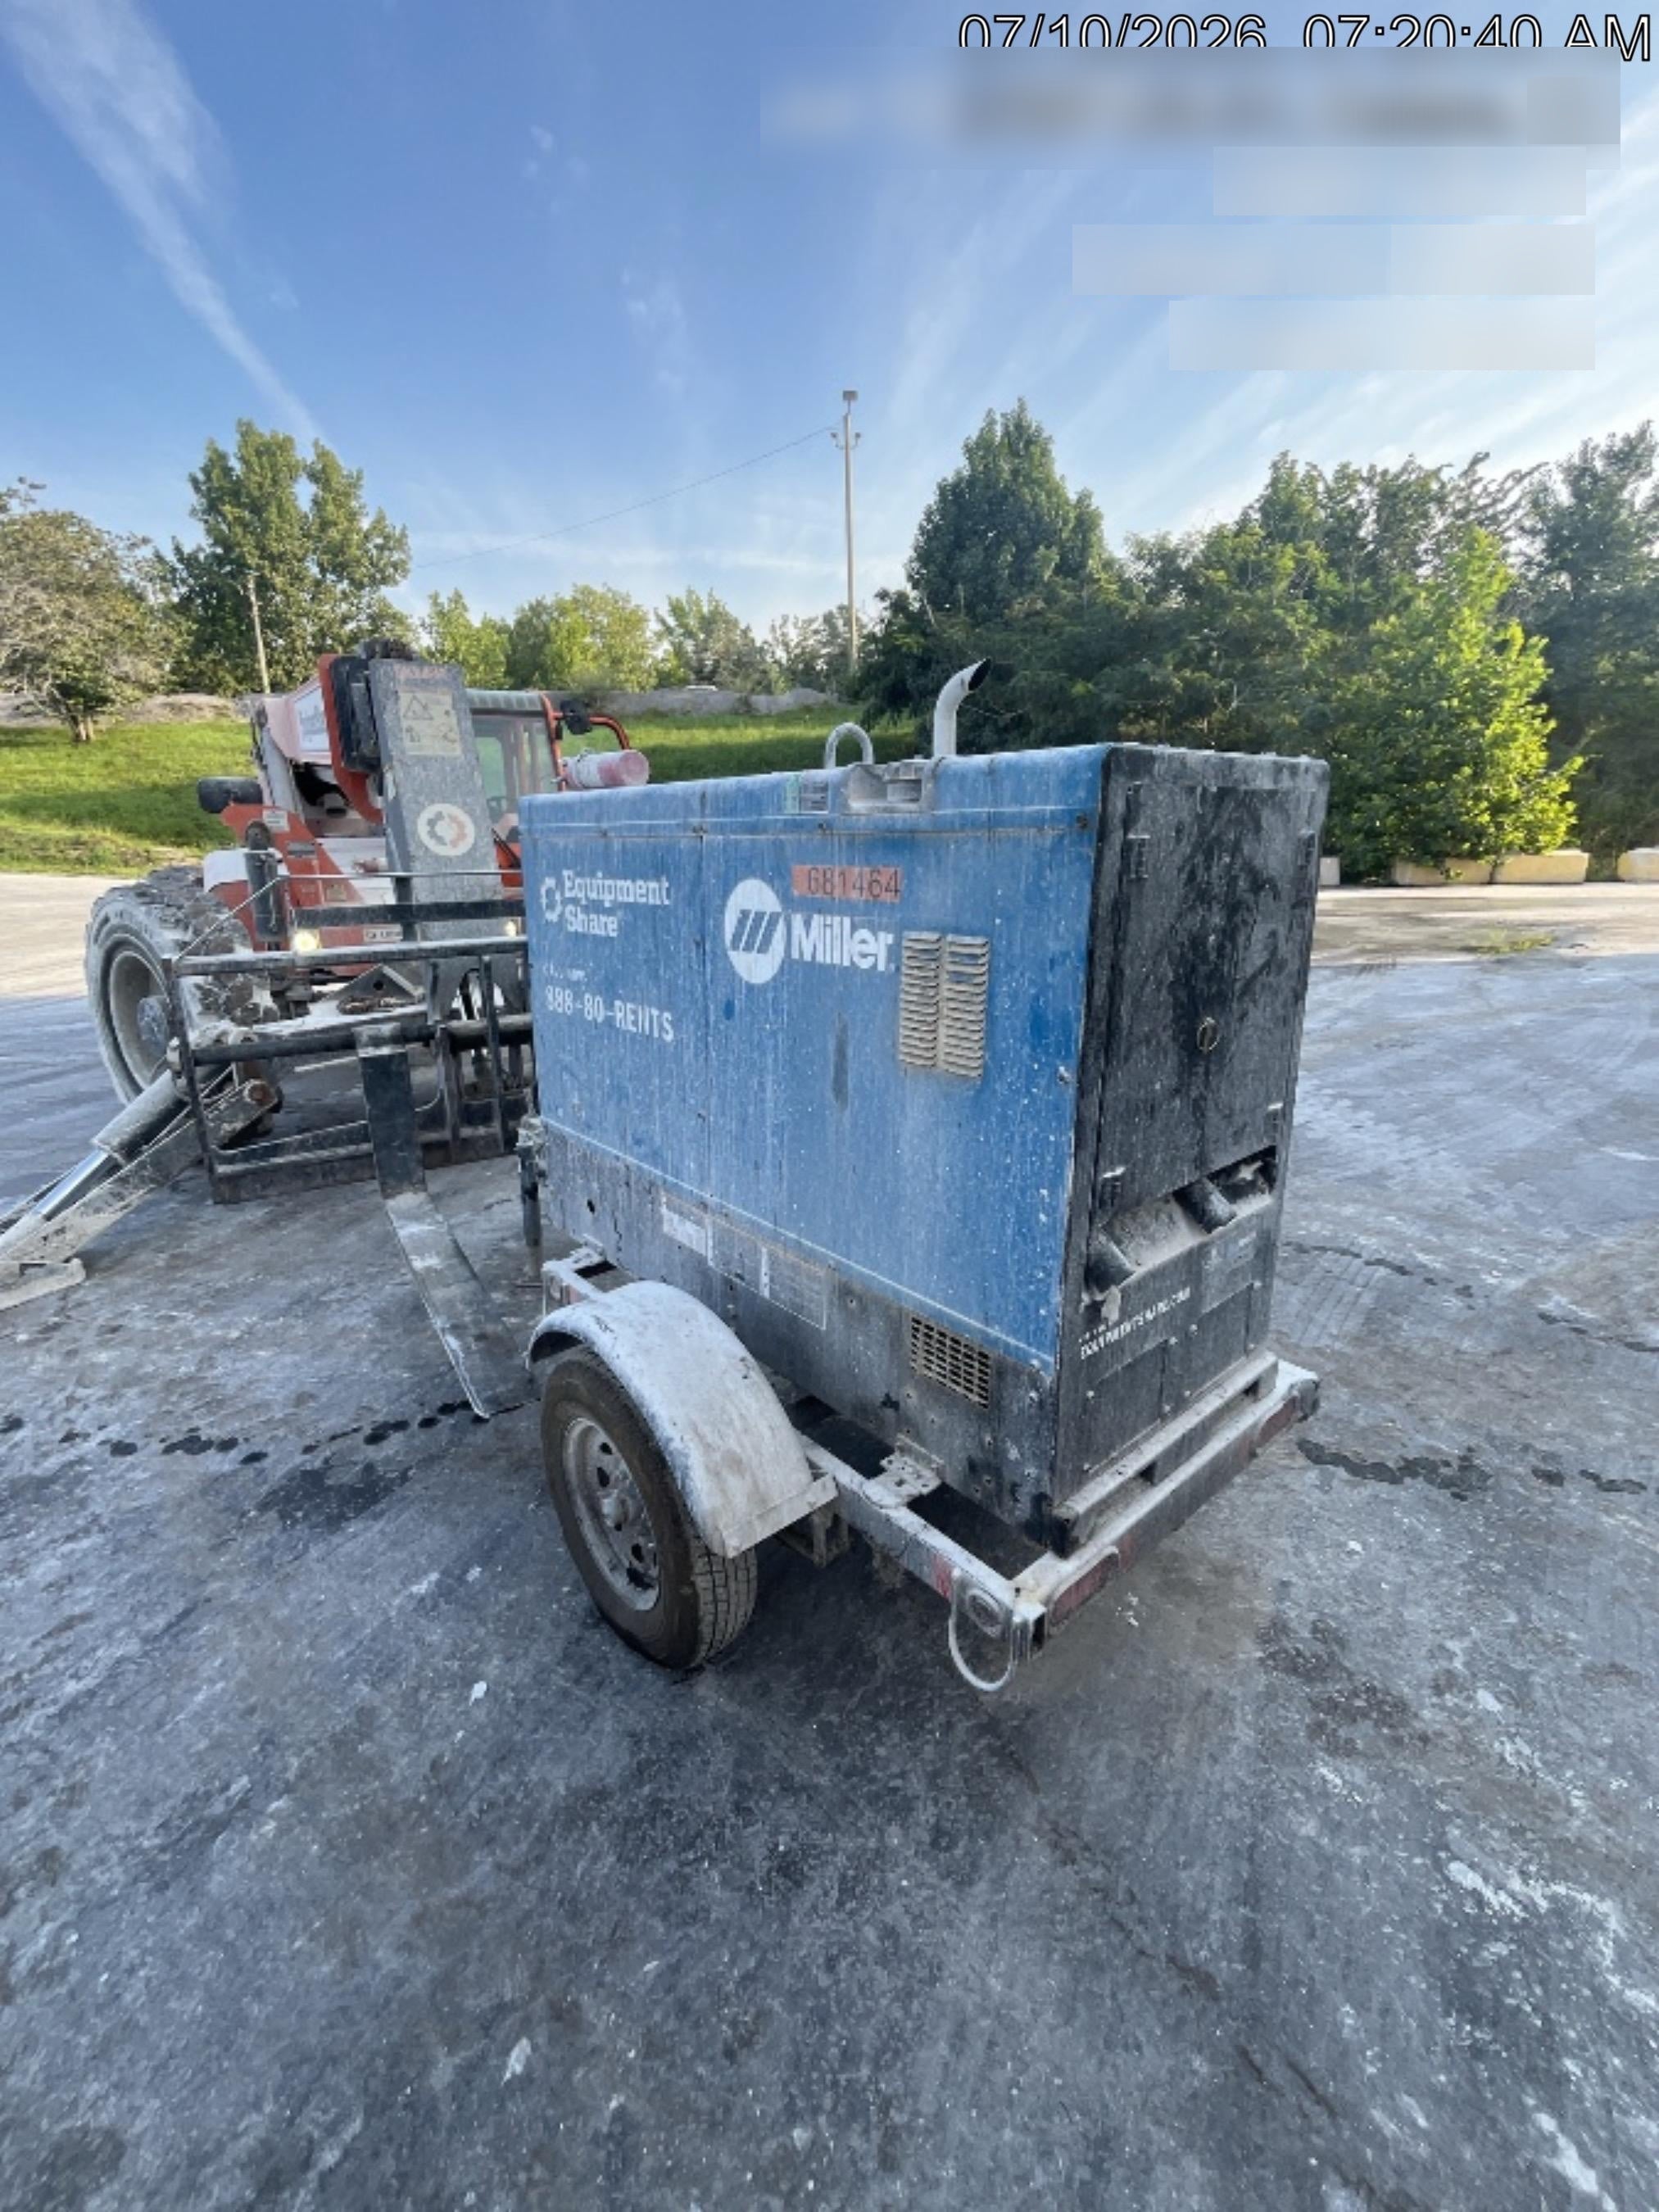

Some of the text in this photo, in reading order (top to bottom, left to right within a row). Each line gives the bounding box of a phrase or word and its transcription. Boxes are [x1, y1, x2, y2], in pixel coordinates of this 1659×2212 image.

[562, 869, 670, 907] Equipment
[564, 904, 619, 937] Share
[791, 913, 894, 971] Miller
